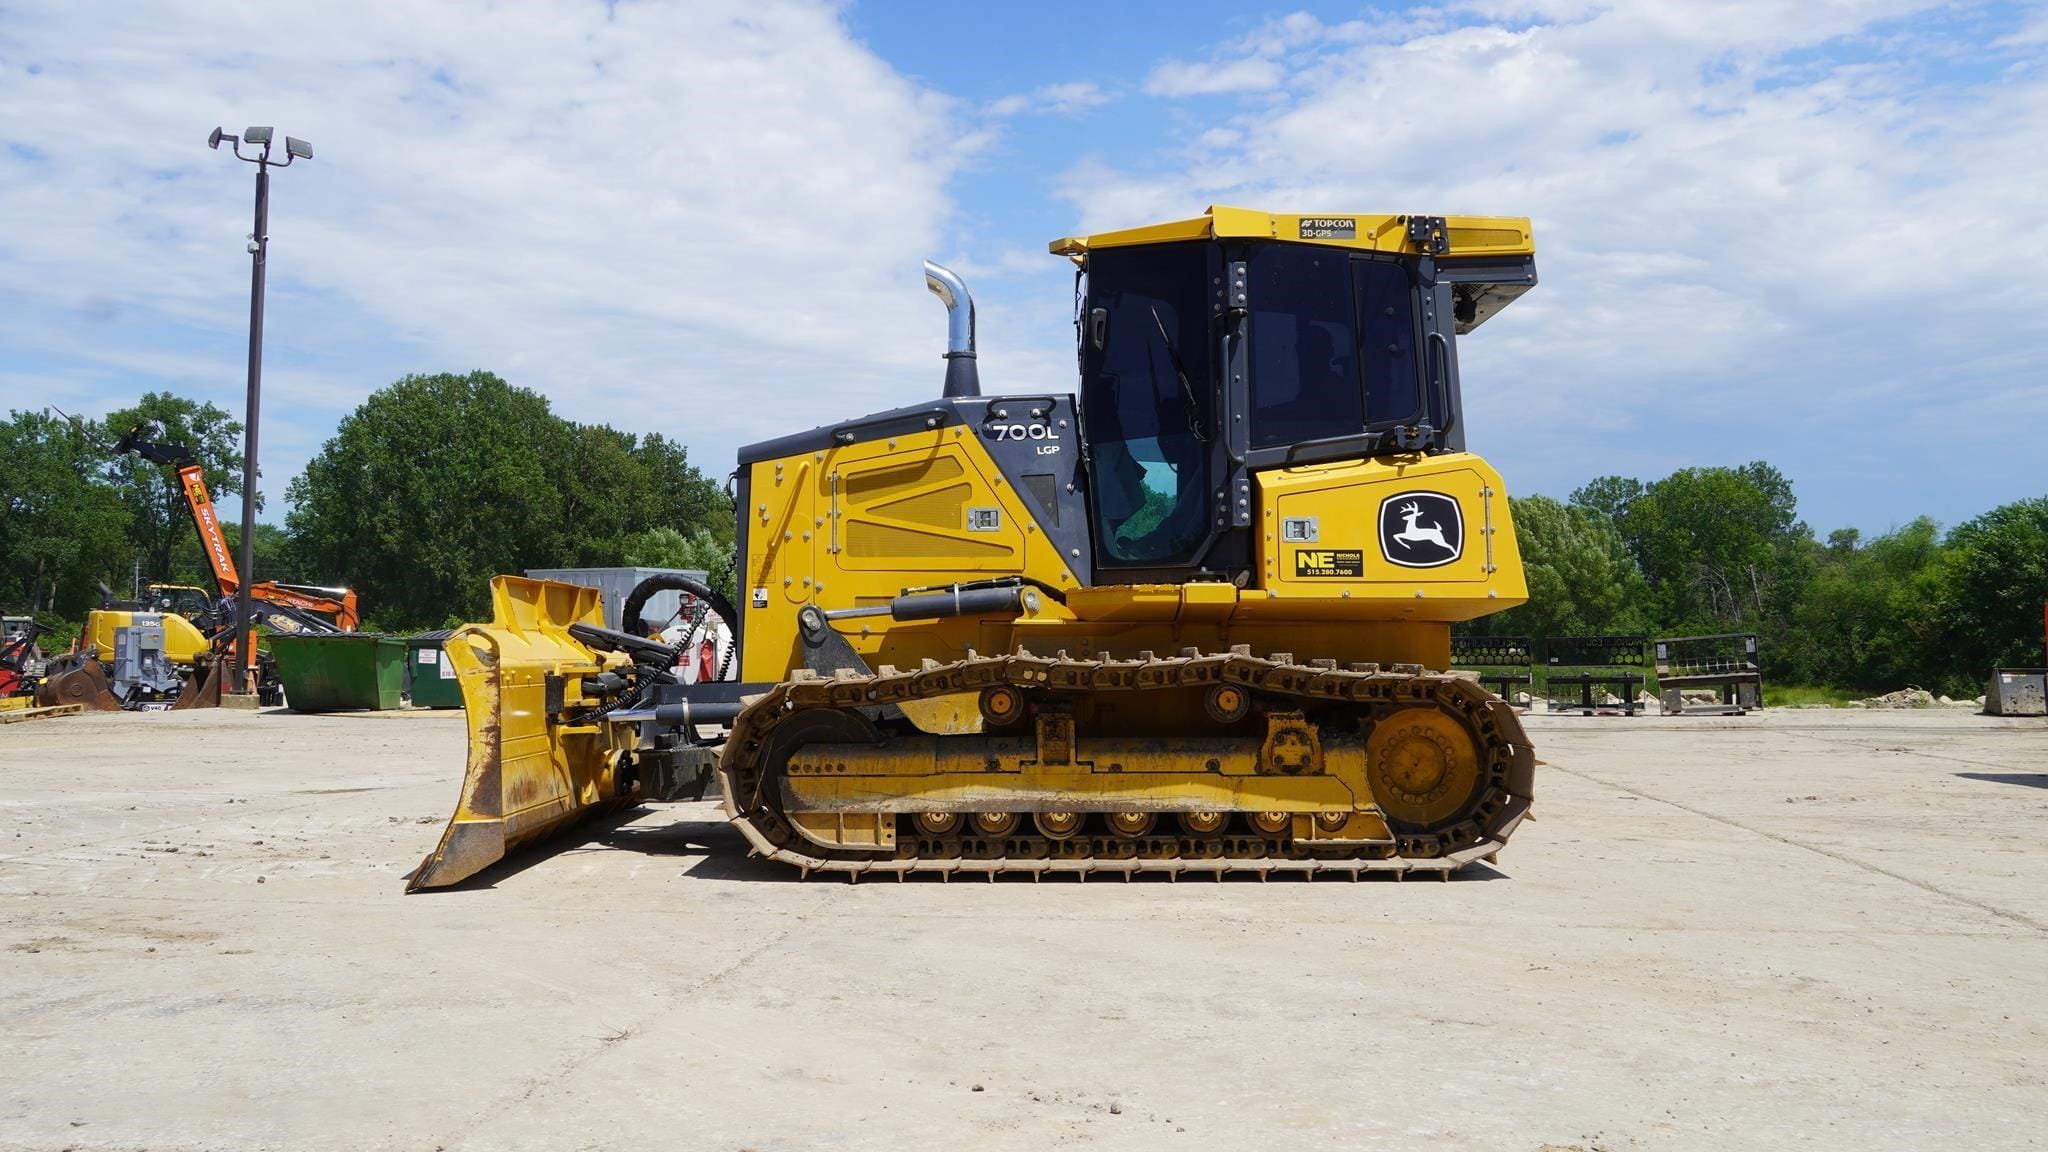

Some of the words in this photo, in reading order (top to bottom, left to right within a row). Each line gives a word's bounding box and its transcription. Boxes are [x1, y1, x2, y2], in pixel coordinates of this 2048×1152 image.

[1314, 219, 1354, 228] TOPCON
[1301, 229, 1332, 237] 3D-GPS
[992, 423, 1060, 442] 700L
[1036, 445, 1060, 455] LGP
[201, 507, 230, 573] SKYTRAK
[1298, 552, 1335, 568] NE
